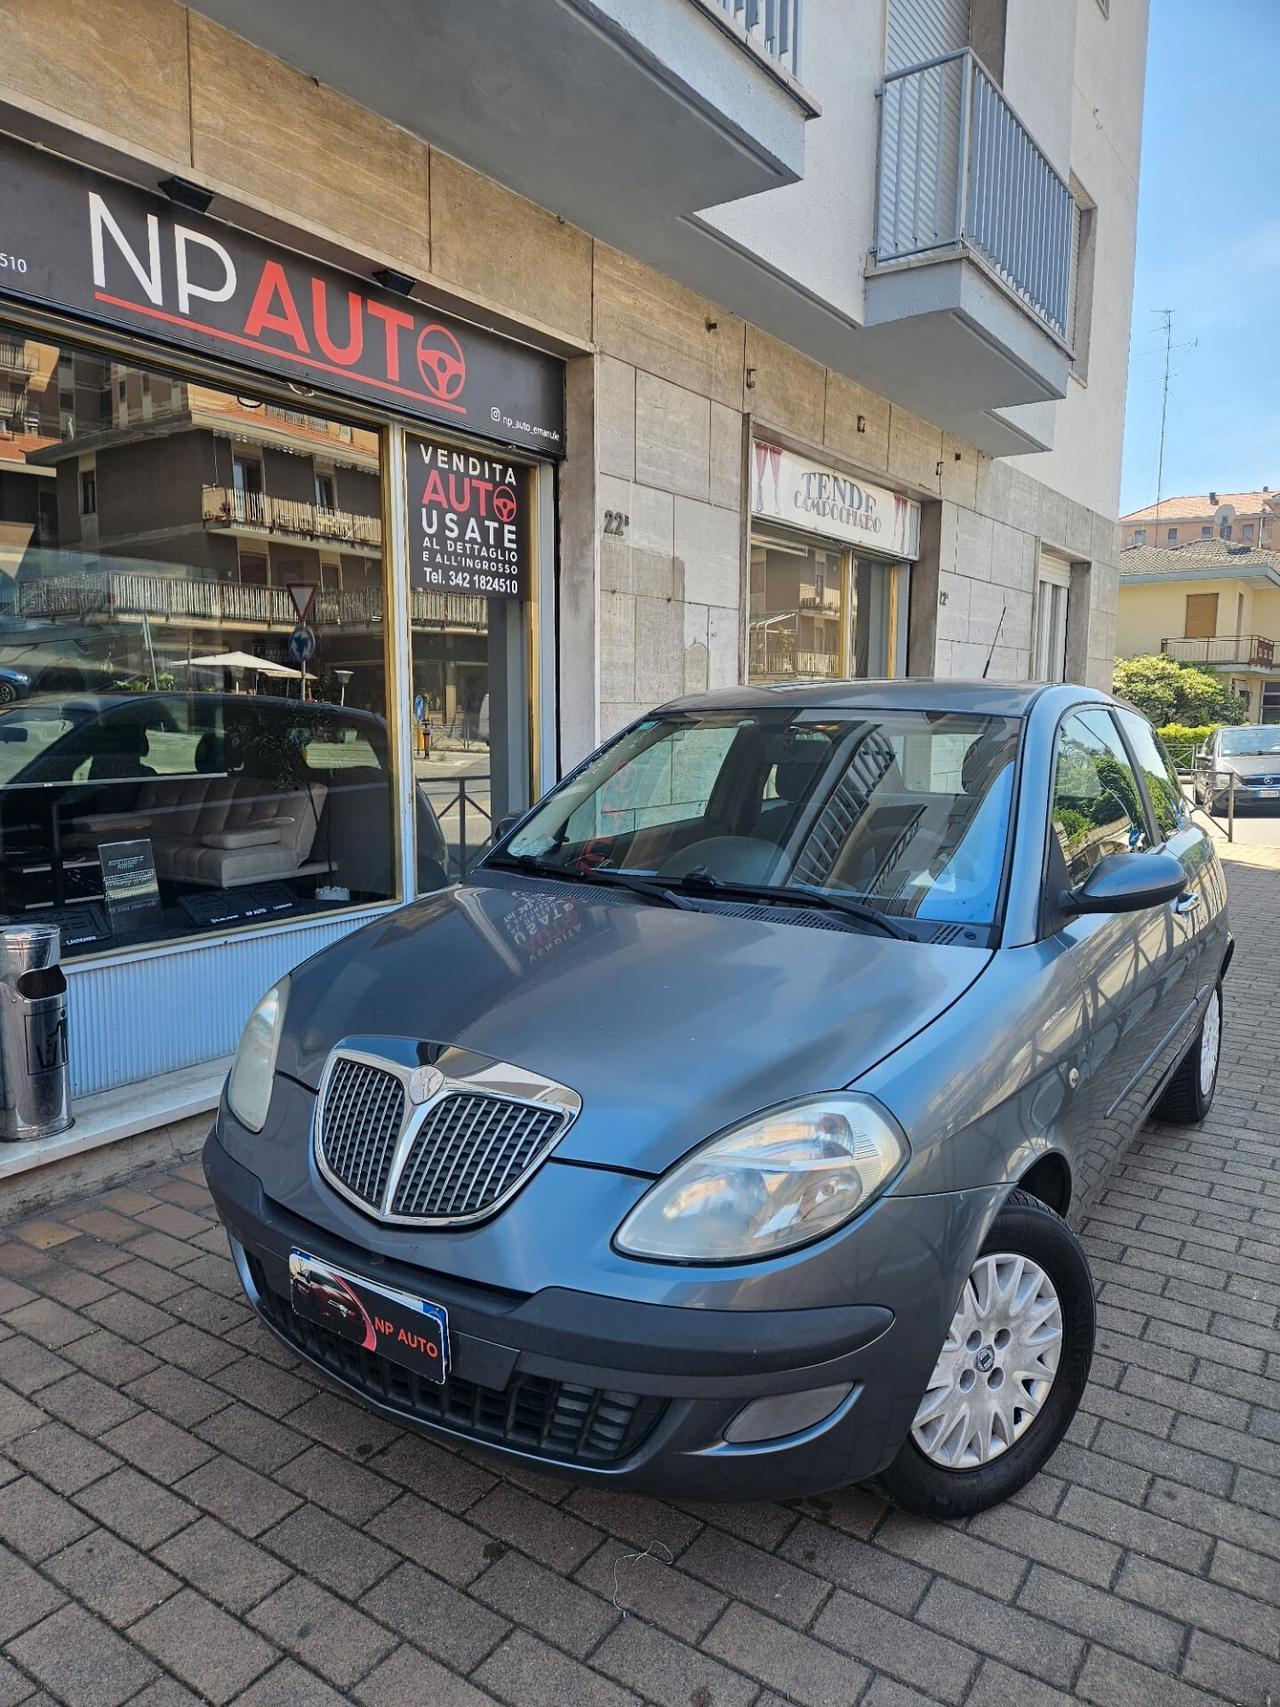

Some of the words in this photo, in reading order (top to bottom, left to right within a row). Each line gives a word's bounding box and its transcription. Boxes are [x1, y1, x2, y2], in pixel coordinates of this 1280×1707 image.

[88, 191, 237, 315] NP
[420, 443, 517, 486] VENDITA
[421, 507, 517, 549] USATE
[423, 536, 440, 549] AL
[447, 540, 518, 562] DETTAGLIO
[423, 551, 430, 562] E
[435, 553, 518, 575] ALL'INGROSSO
[424, 567, 446, 585] Tel.
[449, 570, 470, 588] 342
[473, 574, 518, 594] 1824510
[374, 1316, 394, 1336] NP
[398, 1328, 438, 1359] AUTO
